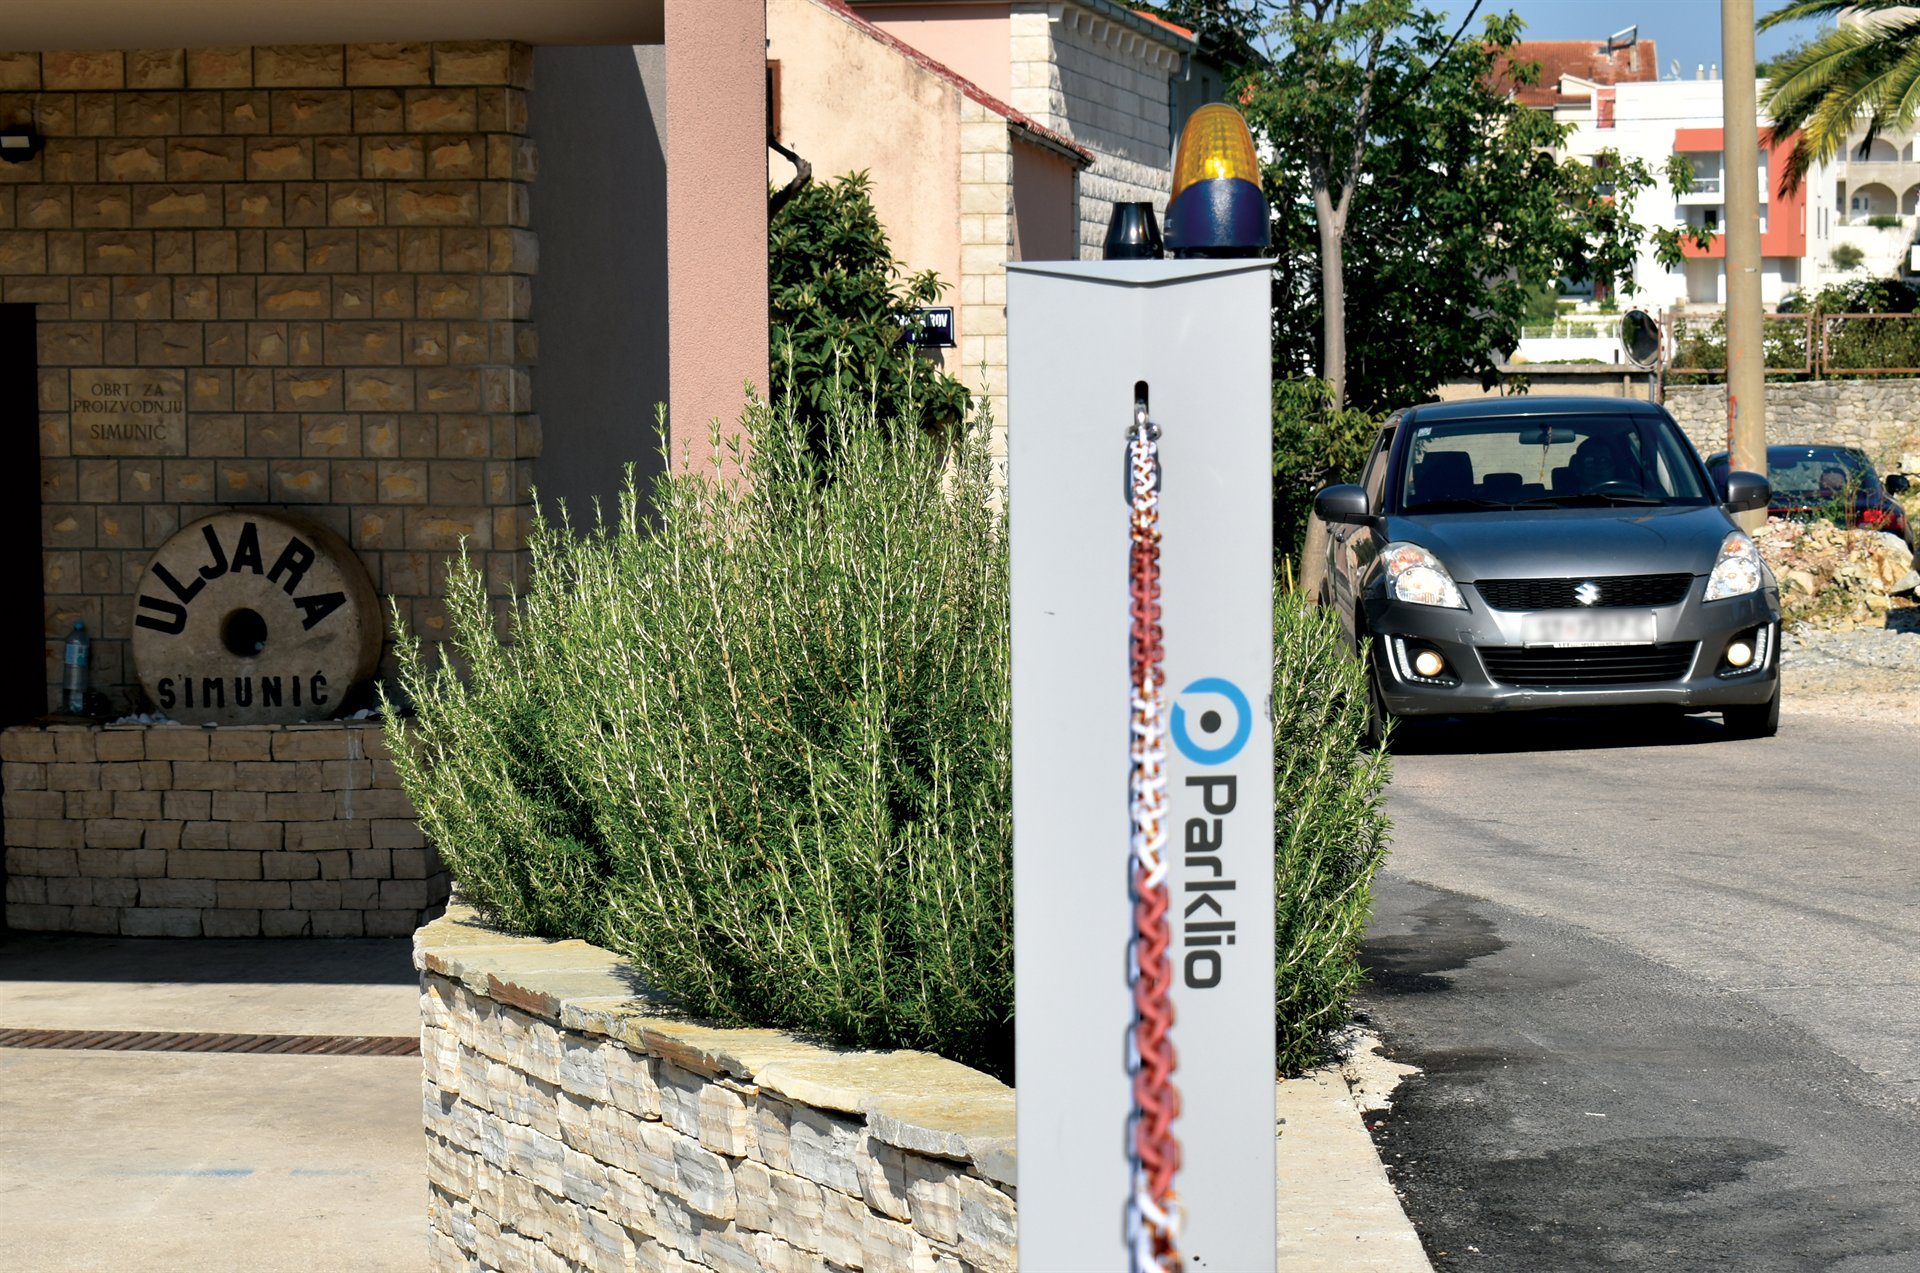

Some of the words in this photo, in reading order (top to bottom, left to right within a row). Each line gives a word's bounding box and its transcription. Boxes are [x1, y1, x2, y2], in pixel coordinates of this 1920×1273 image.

[74, 400, 183, 414] PROIZVODNJU
[91, 383, 133, 397] OBRT
[143, 383, 165, 397] ZA
[135, 521, 347, 635] ULJARA
[1184, 774, 1237, 989] Parklio
